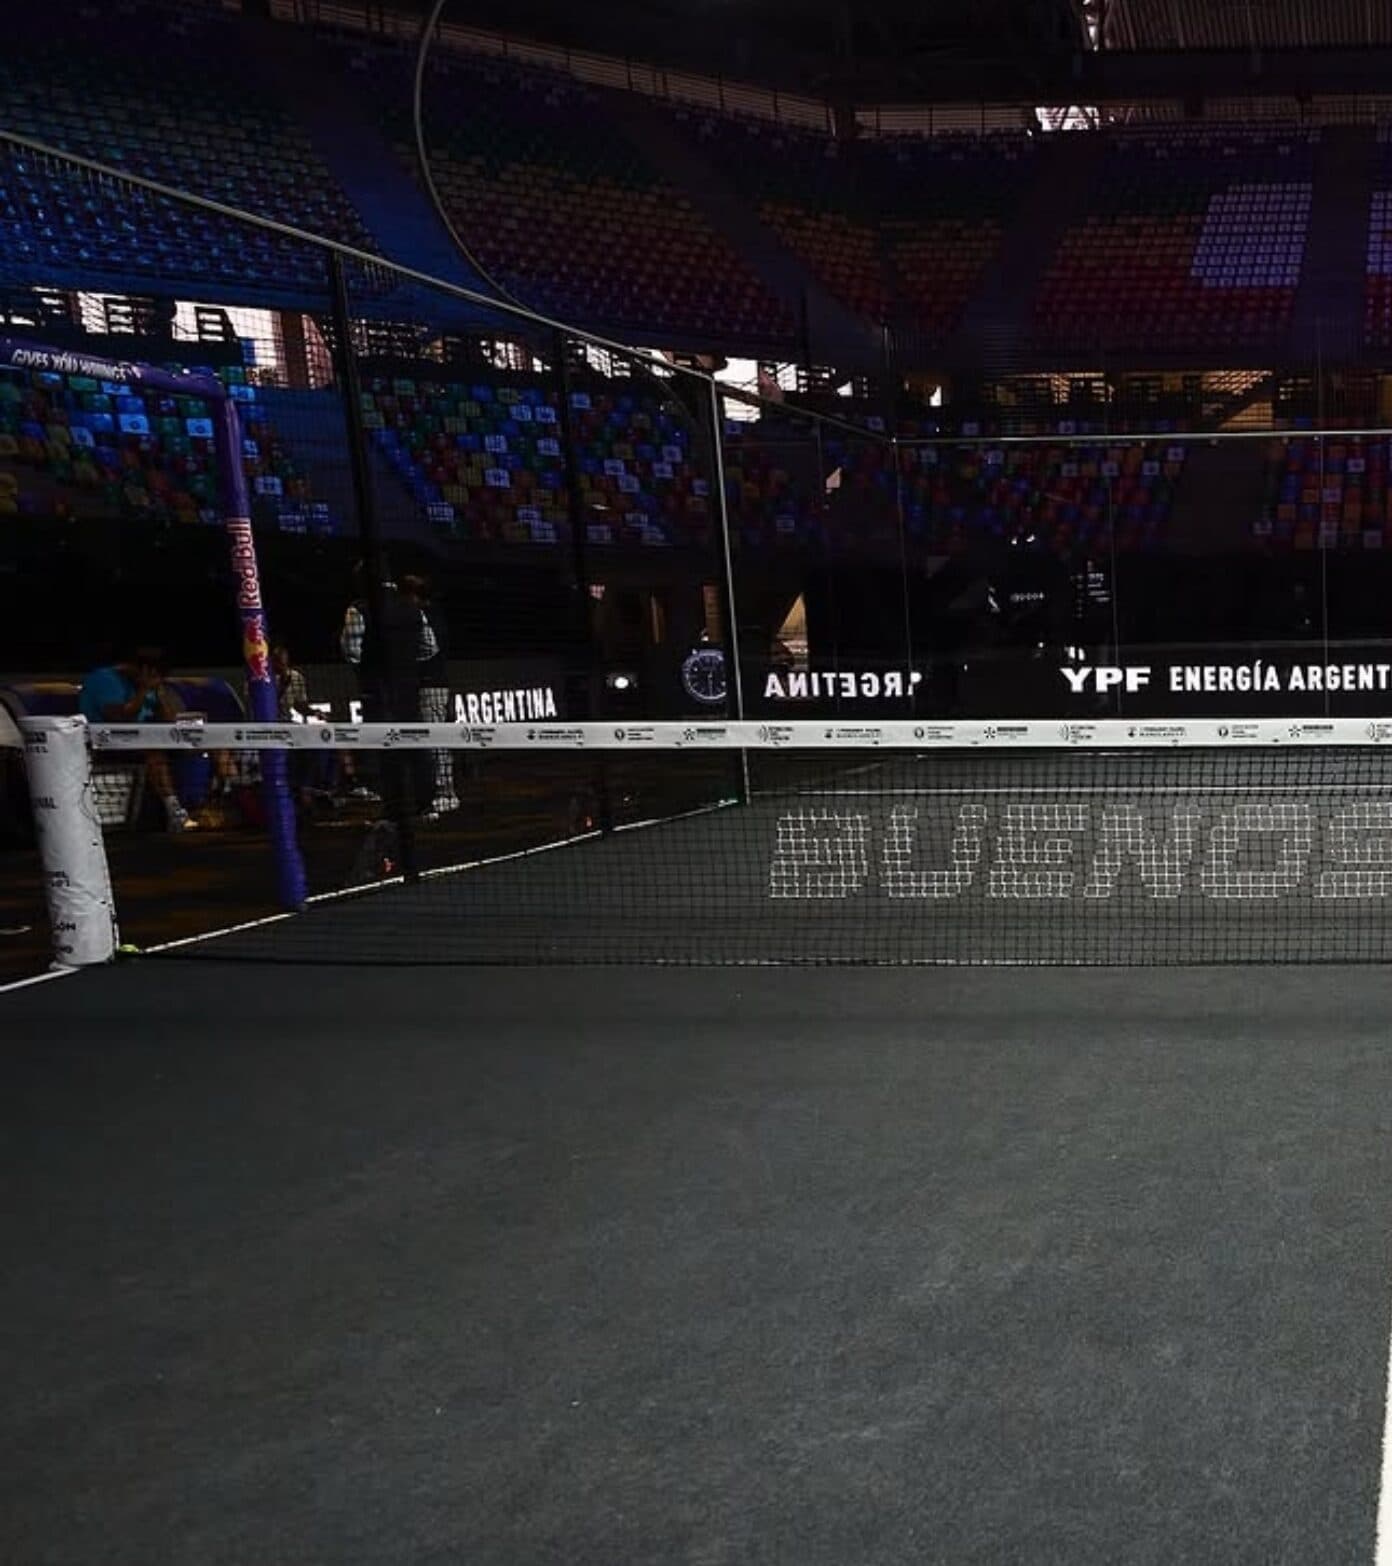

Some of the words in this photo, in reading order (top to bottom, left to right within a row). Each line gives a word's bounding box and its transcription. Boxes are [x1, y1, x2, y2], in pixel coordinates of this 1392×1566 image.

[228, 517, 255, 560] Bull
[235, 562, 261, 608] Red
[1060, 666, 1151, 692] YPF
[1169, 659, 1281, 692] ENERGÍA
[455, 688, 557, 724] ARGENTINA
